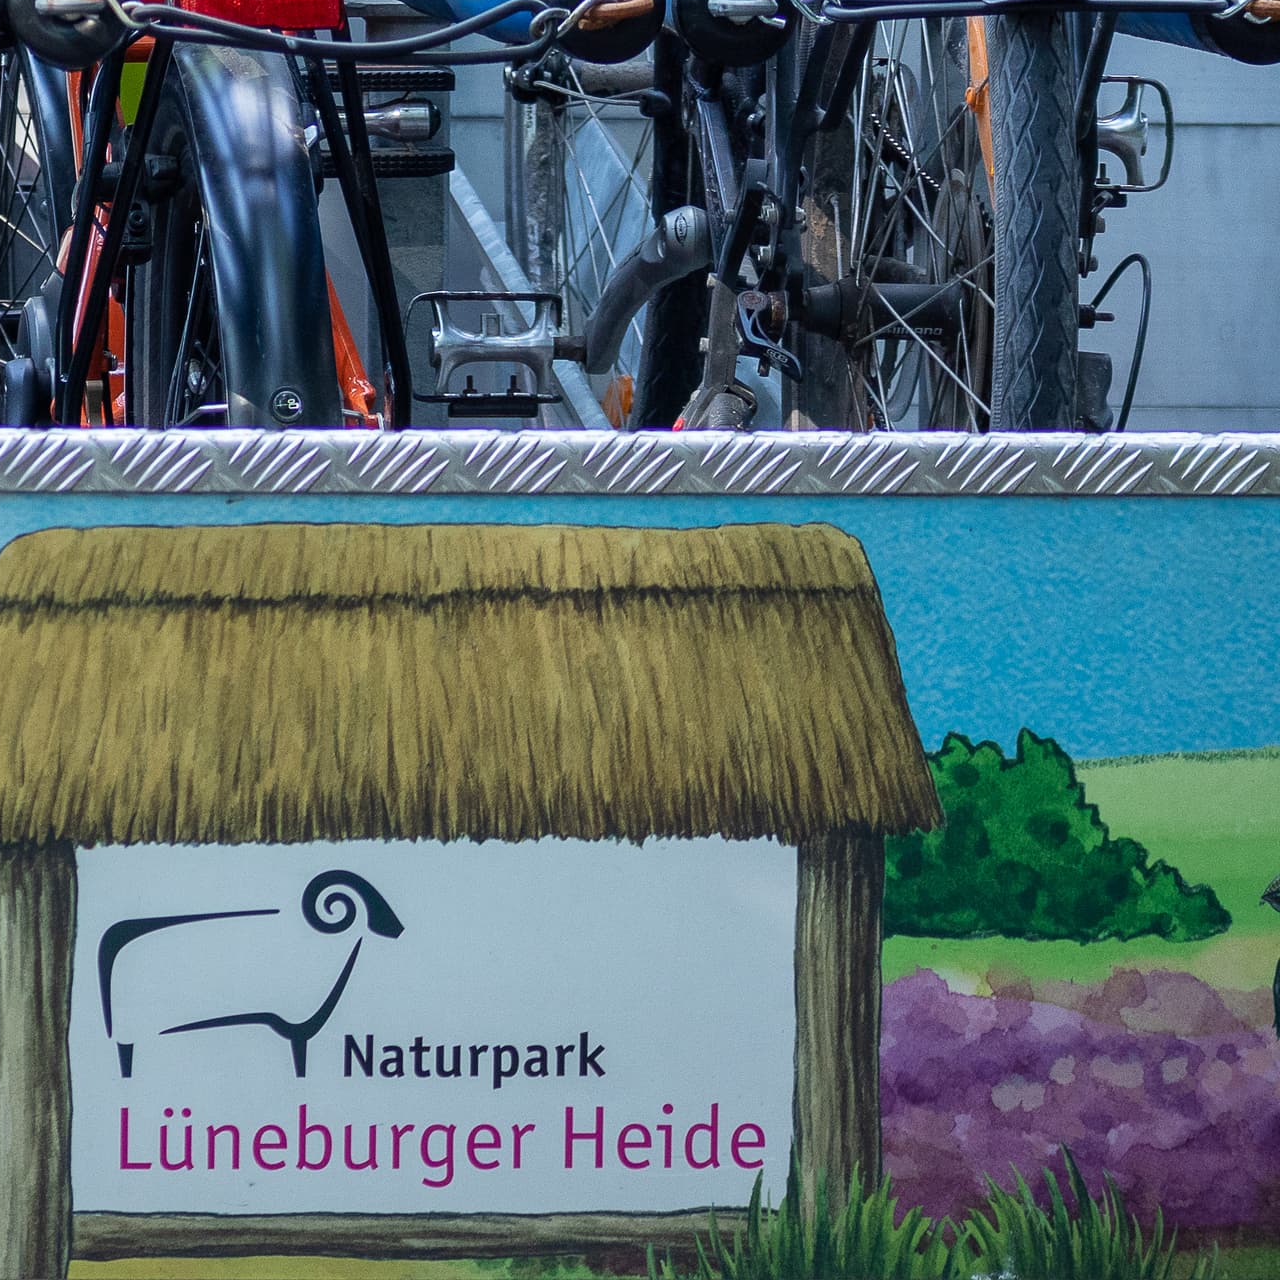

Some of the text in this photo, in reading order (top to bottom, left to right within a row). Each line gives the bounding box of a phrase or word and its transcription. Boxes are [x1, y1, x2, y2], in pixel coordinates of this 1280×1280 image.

[344, 1032, 606, 1090] Naturpark
[120, 1104, 765, 1188] Lüneburger Heide
